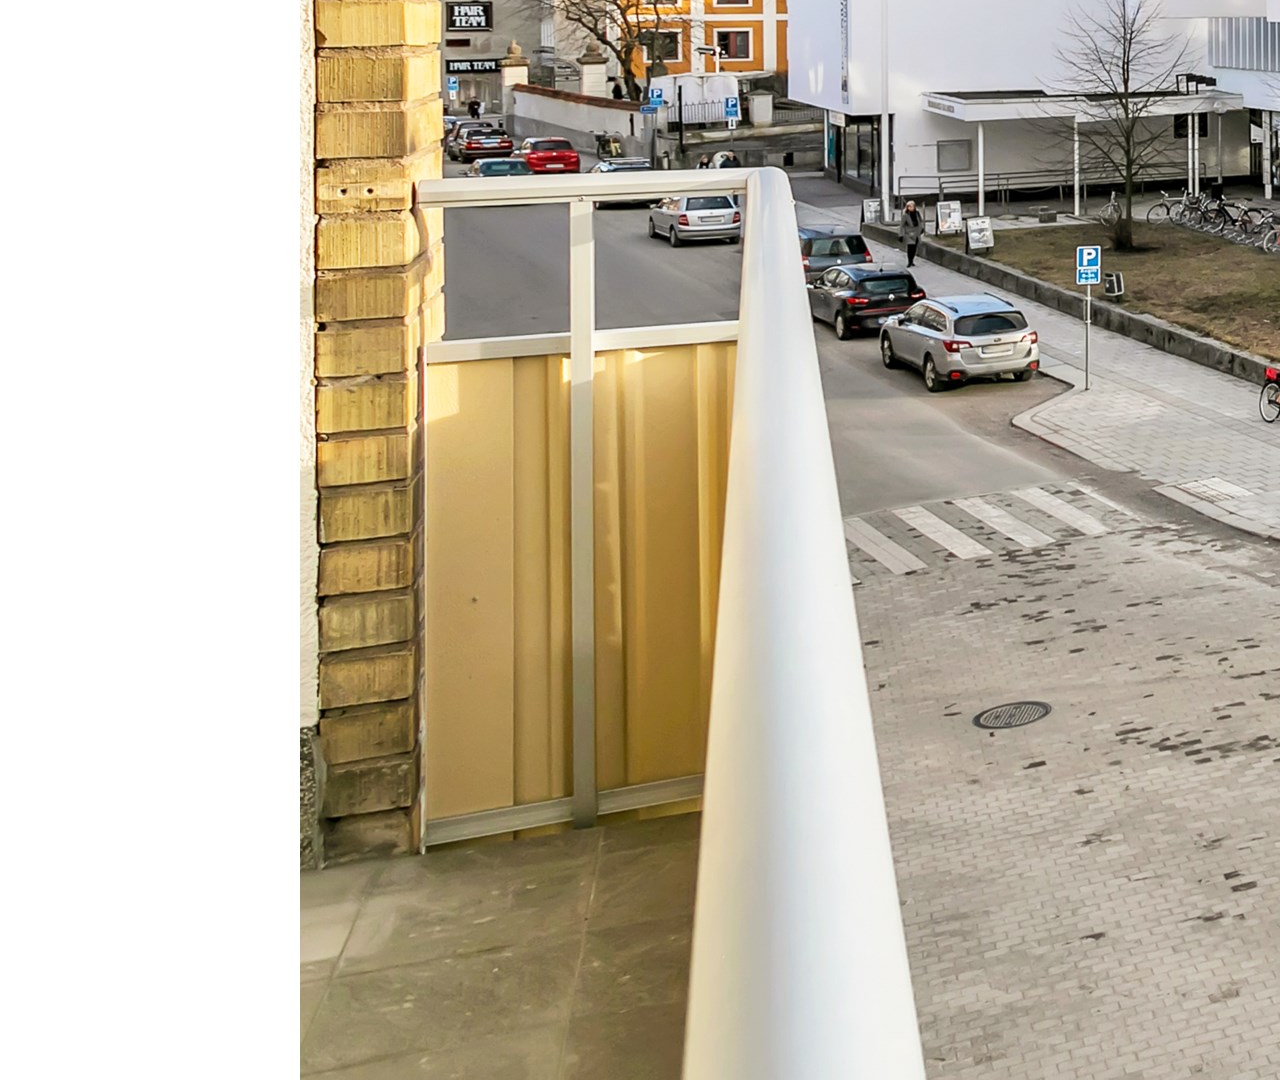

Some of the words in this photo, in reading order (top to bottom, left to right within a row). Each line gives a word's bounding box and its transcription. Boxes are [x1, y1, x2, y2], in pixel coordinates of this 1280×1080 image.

[453, 5, 485, 16] HAIR
[452, 16, 486, 27] TEAM
[449, 61, 472, 71] HAIR
[472, 61, 496, 70] TEAM
[653, 89, 662, 99] P
[728, 98, 736, 108] P
[1082, 248, 1097, 266] P
